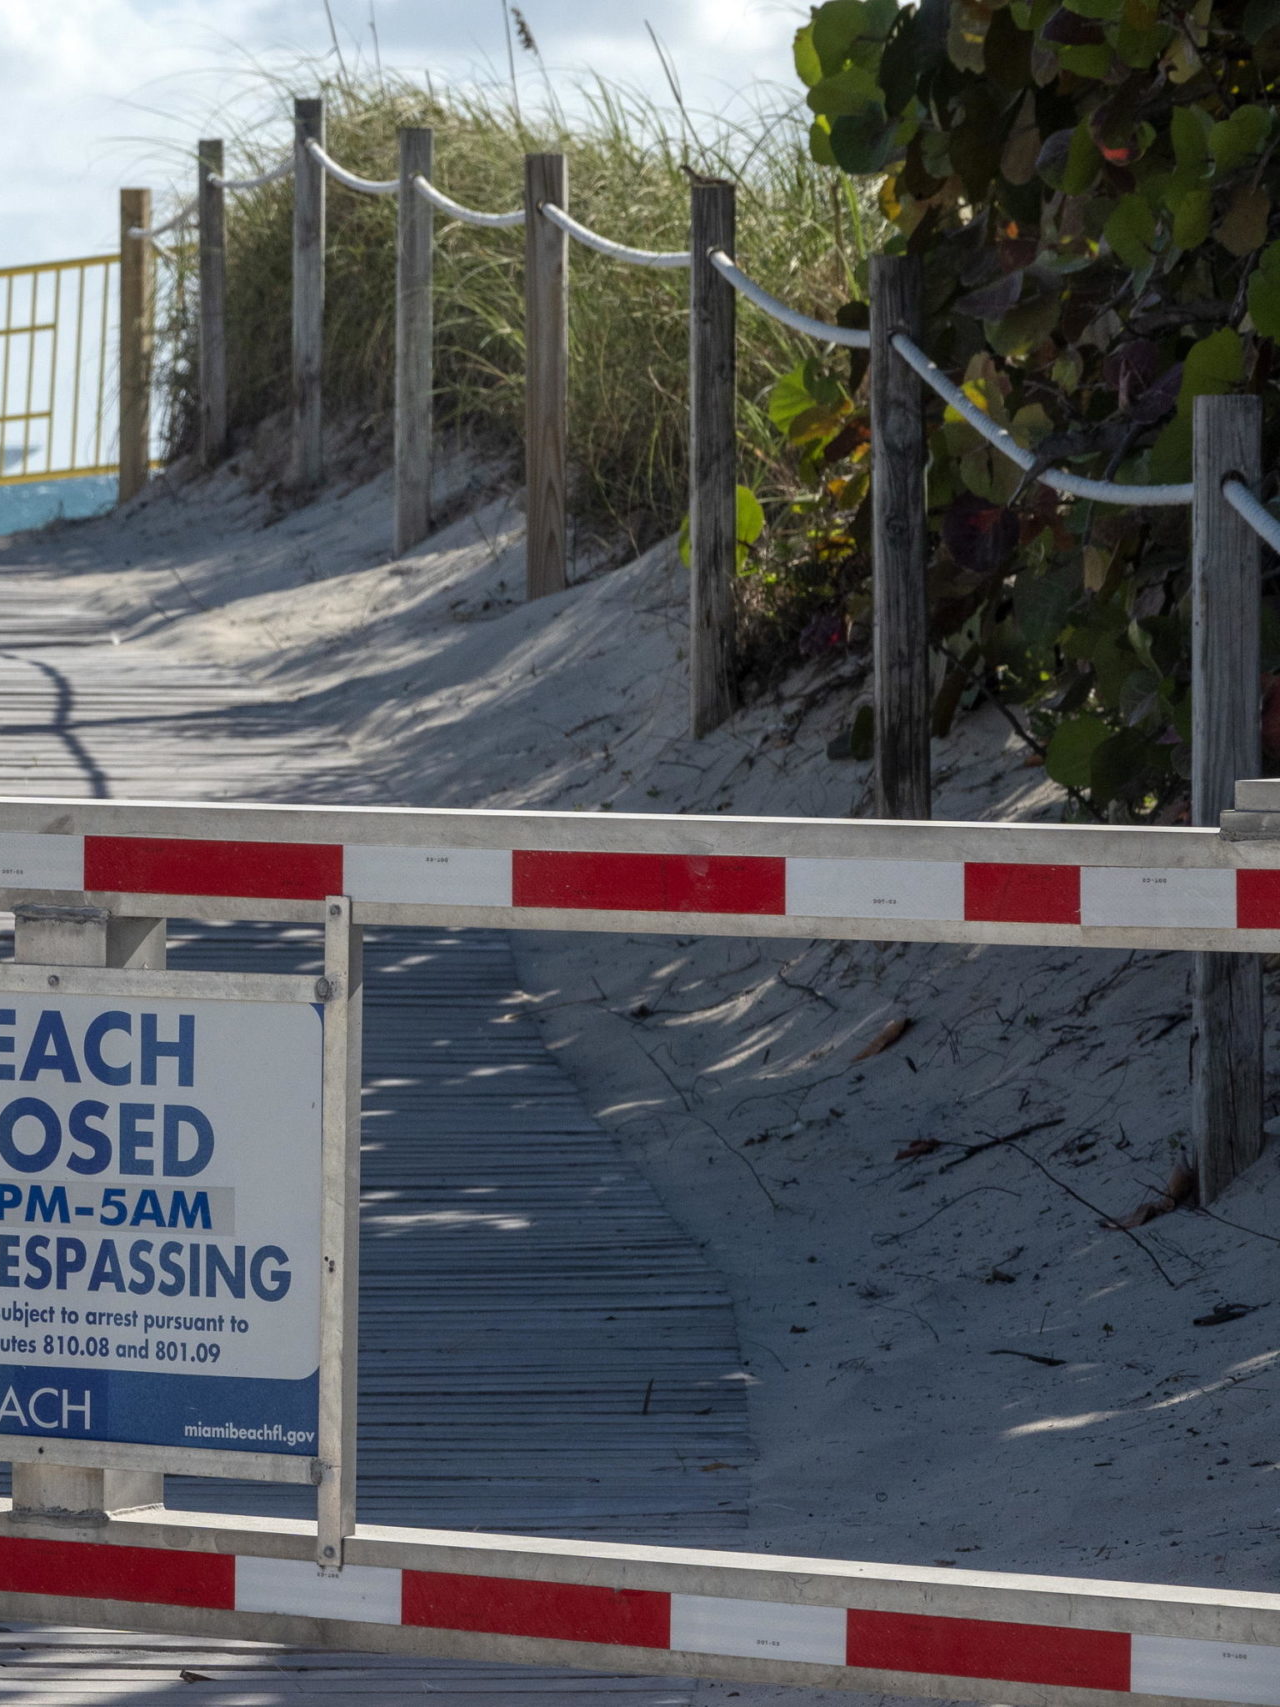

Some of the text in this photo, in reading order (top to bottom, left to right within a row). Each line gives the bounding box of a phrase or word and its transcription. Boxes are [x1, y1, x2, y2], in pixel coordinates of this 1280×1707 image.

[61, 1307, 78, 1324] to
[86, 1311, 138, 1327] arrest
[144, 1315, 224, 1333] pursuant
[230, 1316, 248, 1333] to
[44, 1335, 109, 1357] 810.08
[116, 1339, 148, 1359] and
[156, 1341, 220, 1363] 801.09
[185, 1422, 314, 1446] miamibeachfl.gov
